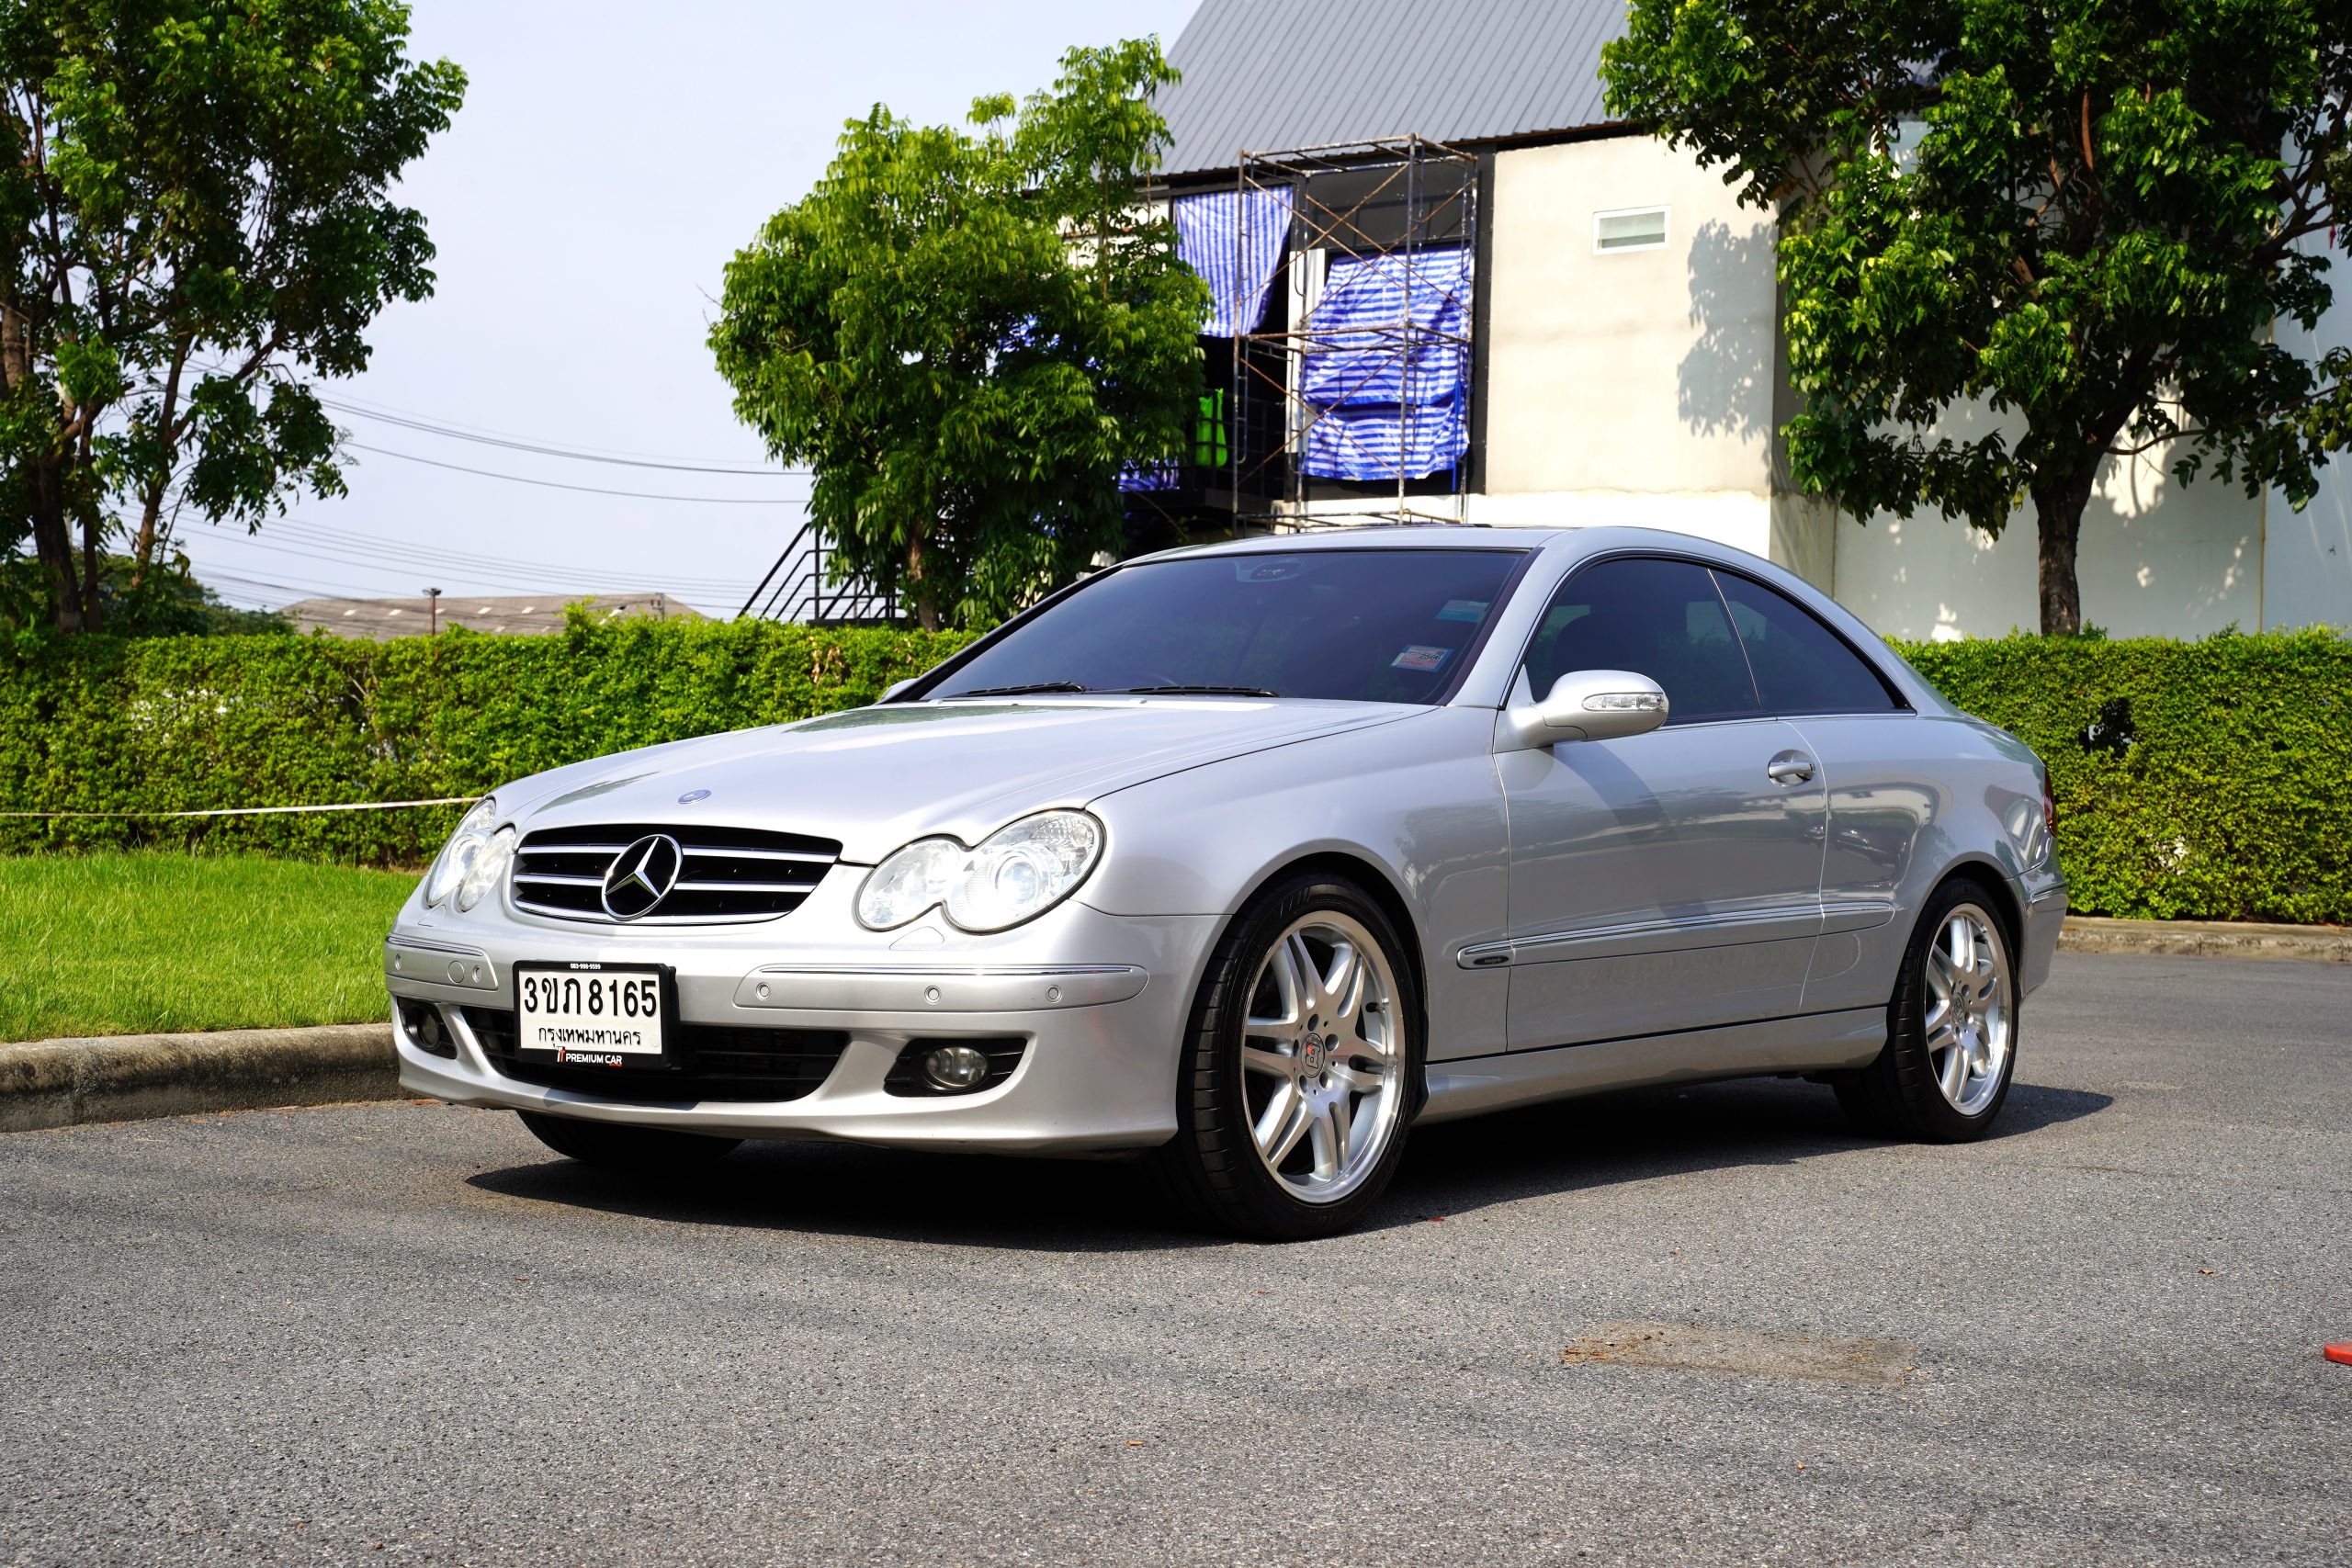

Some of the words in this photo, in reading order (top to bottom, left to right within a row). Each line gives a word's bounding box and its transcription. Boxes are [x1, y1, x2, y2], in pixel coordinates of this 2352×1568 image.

[588, 979, 657, 1018] 8165
[538, 1027, 641, 1047] กรุงเทพมหานคร
[565, 1053, 604, 1064] PREMIUM
[605, 1055, 623, 1065] CAR
